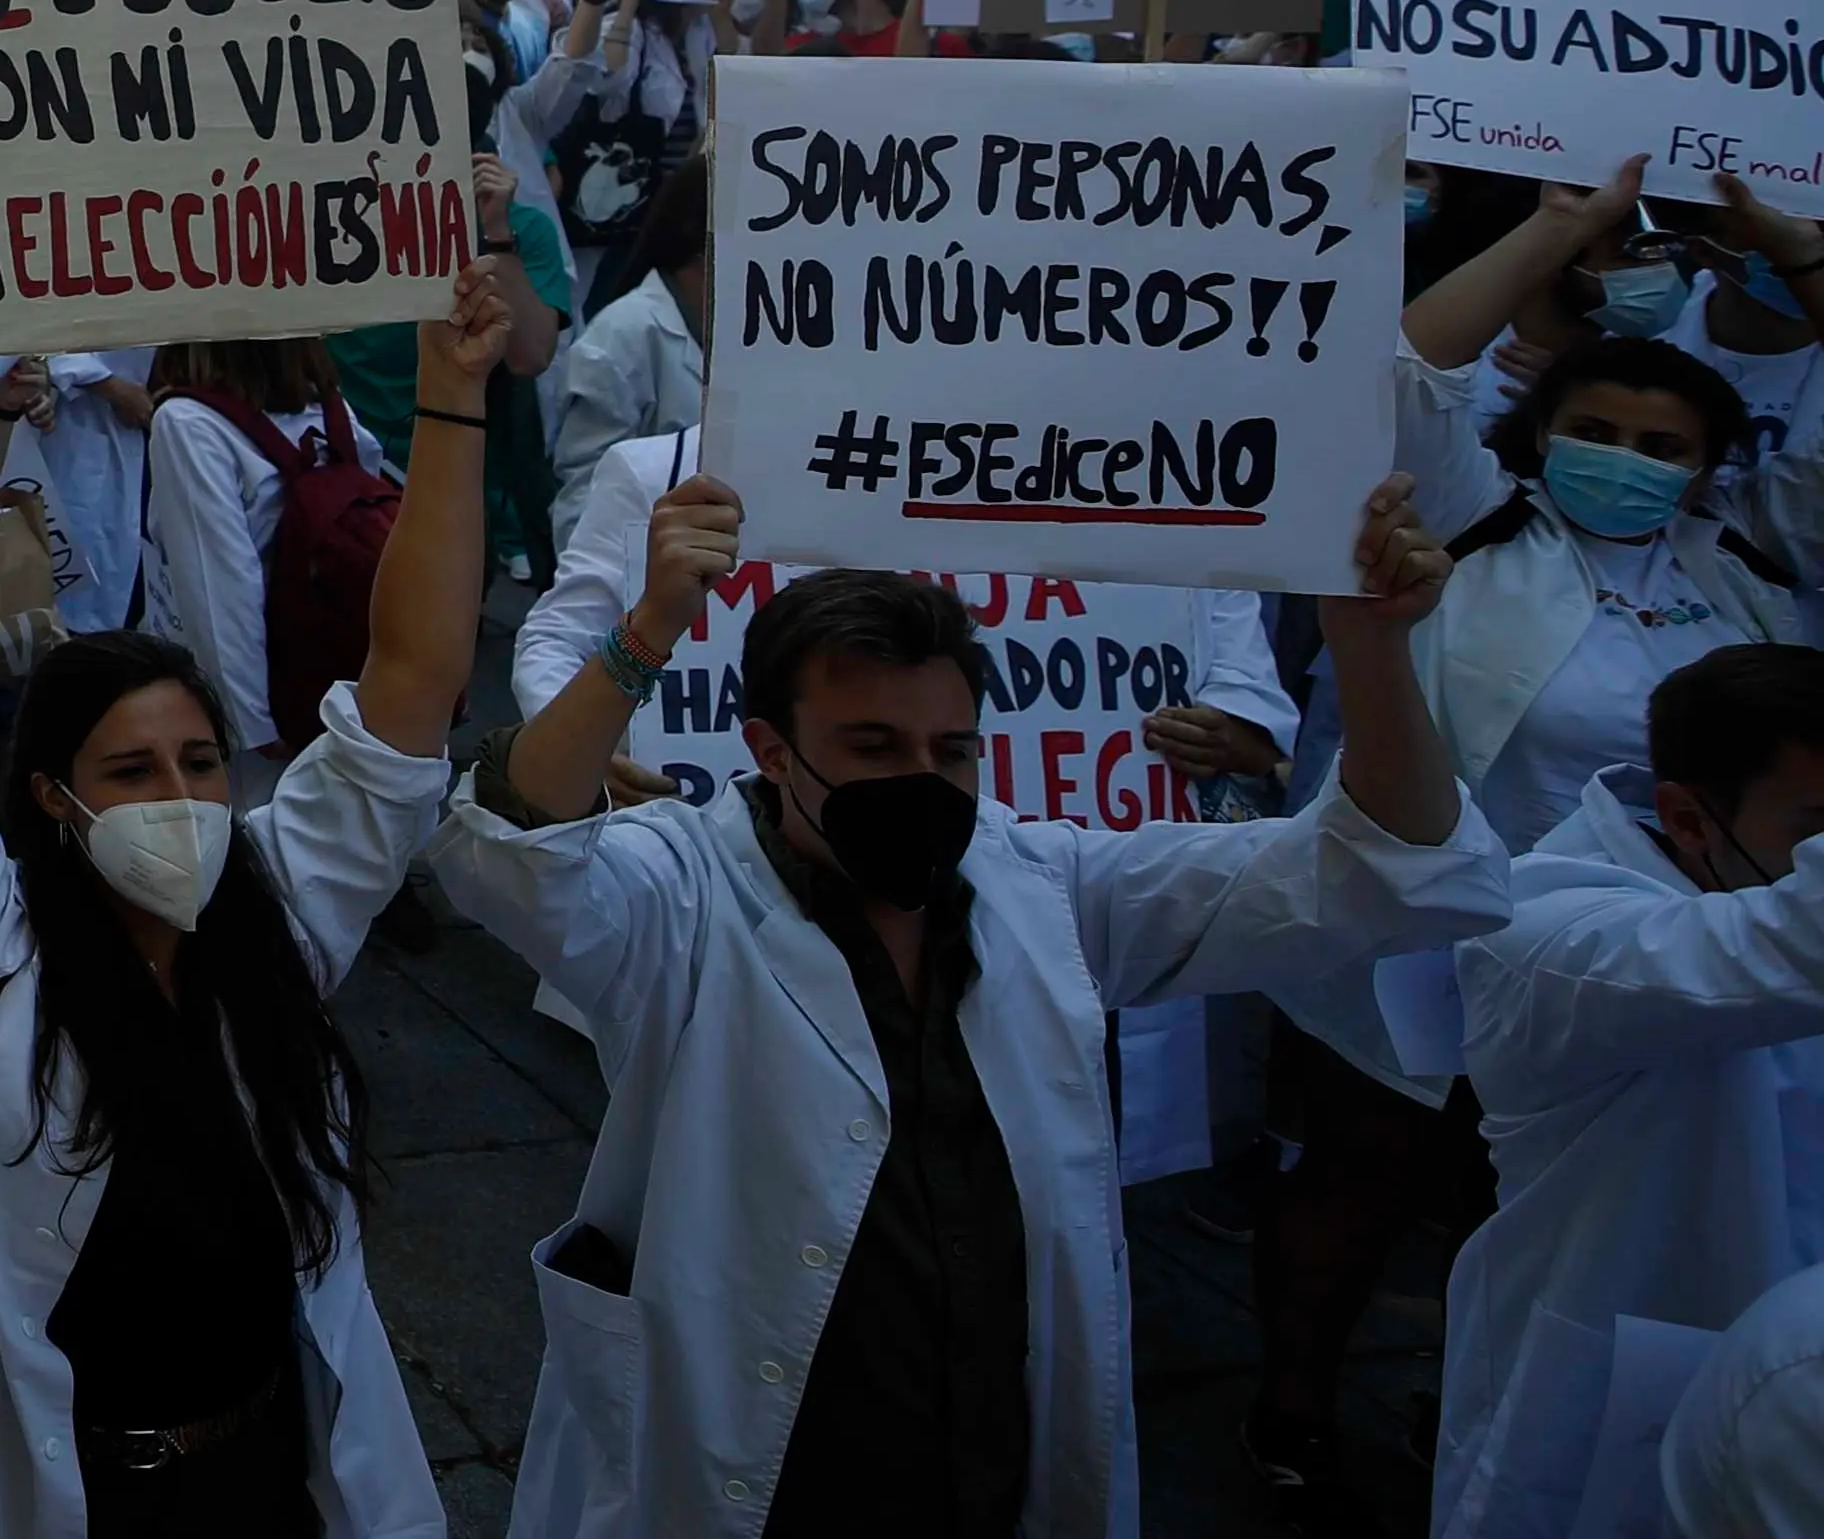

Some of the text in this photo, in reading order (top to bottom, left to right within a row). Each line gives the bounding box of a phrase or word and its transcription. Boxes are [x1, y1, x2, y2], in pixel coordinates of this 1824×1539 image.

[110, 26, 197, 143] MI
[221, 14, 441, 148] VIDA
[1450, 0, 1539, 64] SU
[1409, 95, 1566, 155] FSE unida
[1668, 126, 1742, 174] FSE
[4, 159, 308, 300] ELECCIÓN
[313, 173, 381, 286] ES
[376, 151, 475, 280] MÍA
[748, 125, 1352, 257] SOMOS PERSONAS,
[742, 240, 1339, 364] NO NÚMEROS!!
[805, 410, 1279, 509] #FSEdiceNO
[1096, 635, 1194, 710] POR
